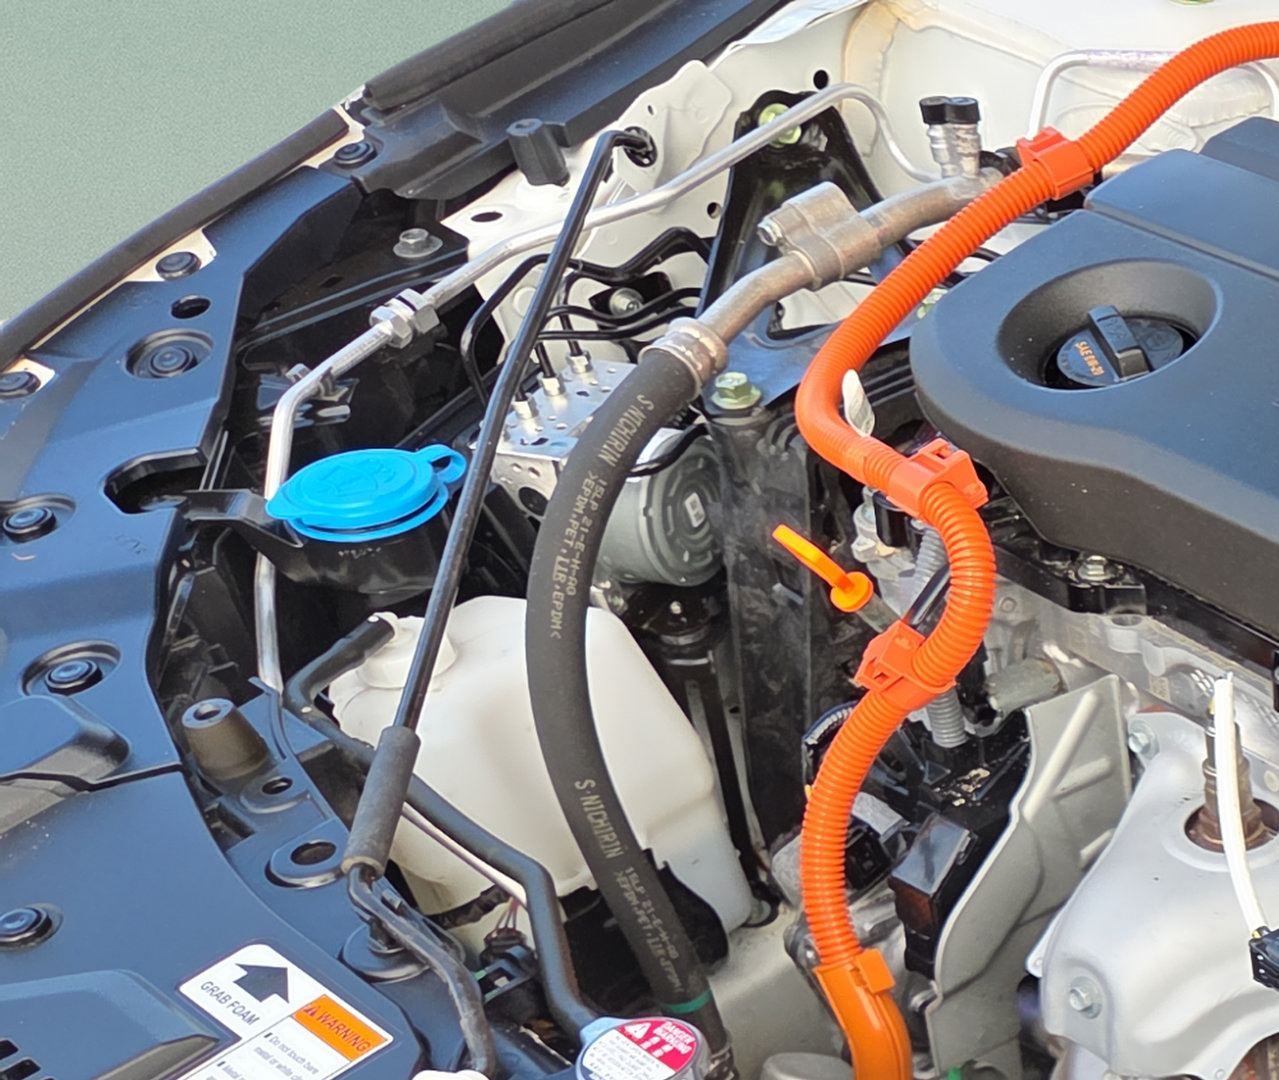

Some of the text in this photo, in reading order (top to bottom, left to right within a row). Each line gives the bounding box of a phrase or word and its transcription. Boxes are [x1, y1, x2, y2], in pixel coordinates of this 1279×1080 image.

[1074, 341, 1093, 356] SAE
[199, 980, 260, 1026] GRAB FOAM
[315, 1010, 372, 1054] WARNING
[663, 1021, 696, 1045] DANGER
[269, 1035, 281, 1045] Do
[277, 1042, 290, 1052] not
[221, 1064, 240, 1079] Metal
[268, 1057, 278, 1065] or
[274, 1061, 293, 1076] white
